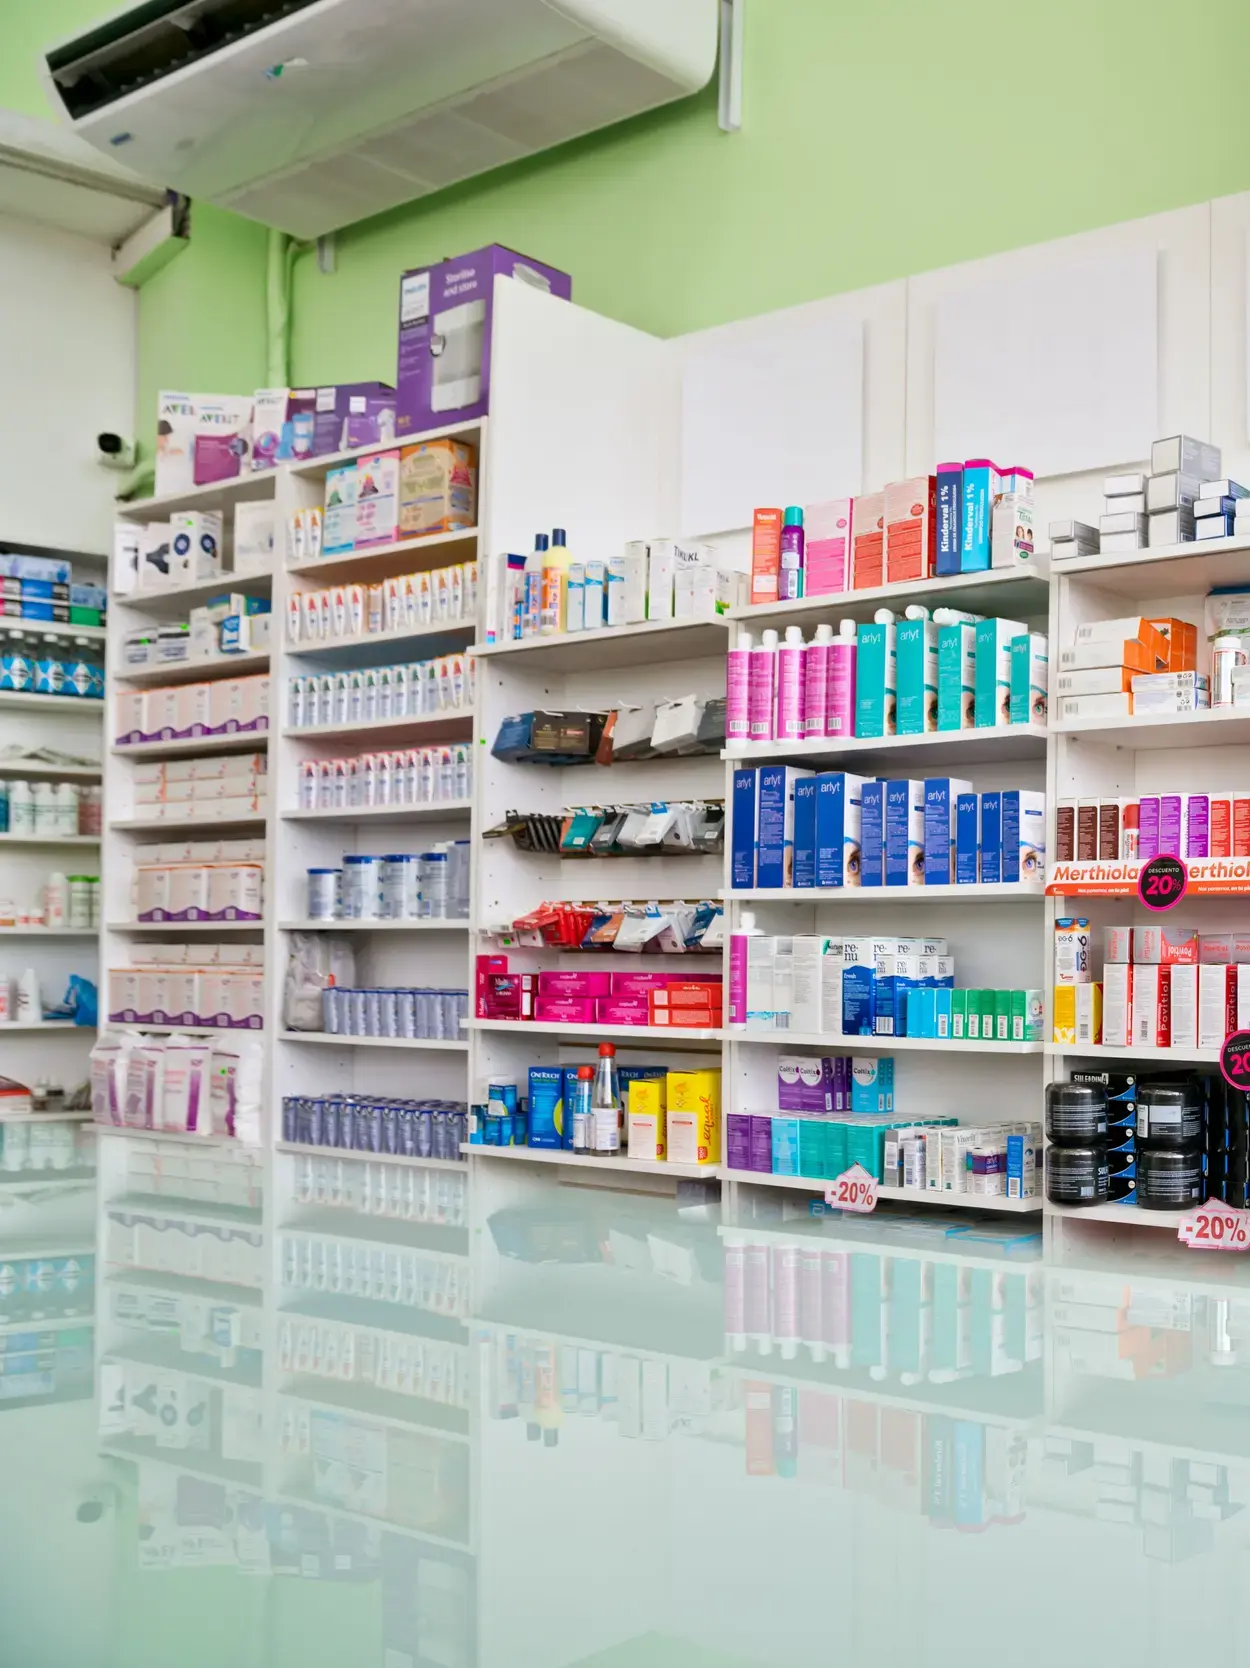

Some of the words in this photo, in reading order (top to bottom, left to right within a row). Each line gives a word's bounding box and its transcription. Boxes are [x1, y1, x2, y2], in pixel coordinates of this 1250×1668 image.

[940, 485, 949, 502] 1%
[966, 483, 975, 499] 1%
[940, 504, 949, 552] Kinderval
[964, 502, 974, 551] Kinderval
[861, 632, 881, 645] arlyt
[900, 629, 920, 643] arlyt
[941, 637, 958, 649] arlyt
[736, 777, 752, 790] arlyt
[763, 774, 781, 788] arlyt
[820, 781, 841, 794] arlyt
[797, 785, 814, 798] arlyt
[889, 792, 906, 804] arlyt
[927, 790, 946, 803] arlyt
[864, 794, 880, 806] arlyt
[959, 801, 975, 813] arlyt
[983, 800, 998, 812] arlyt
[1054, 863, 1141, 881] Merthiola
[1148, 866, 1180, 874] DESCUENTO
[1146, 875, 1182, 896] 20%
[844, 952, 858, 962] nu
[1161, 980, 1169, 1031] Povitiol
[1229, 981, 1237, 1032] Povitiol
[699, 1093, 714, 1146] equal
[830, 1181, 874, 1207] -20%
[1185, 1215, 1246, 1242] -20%
